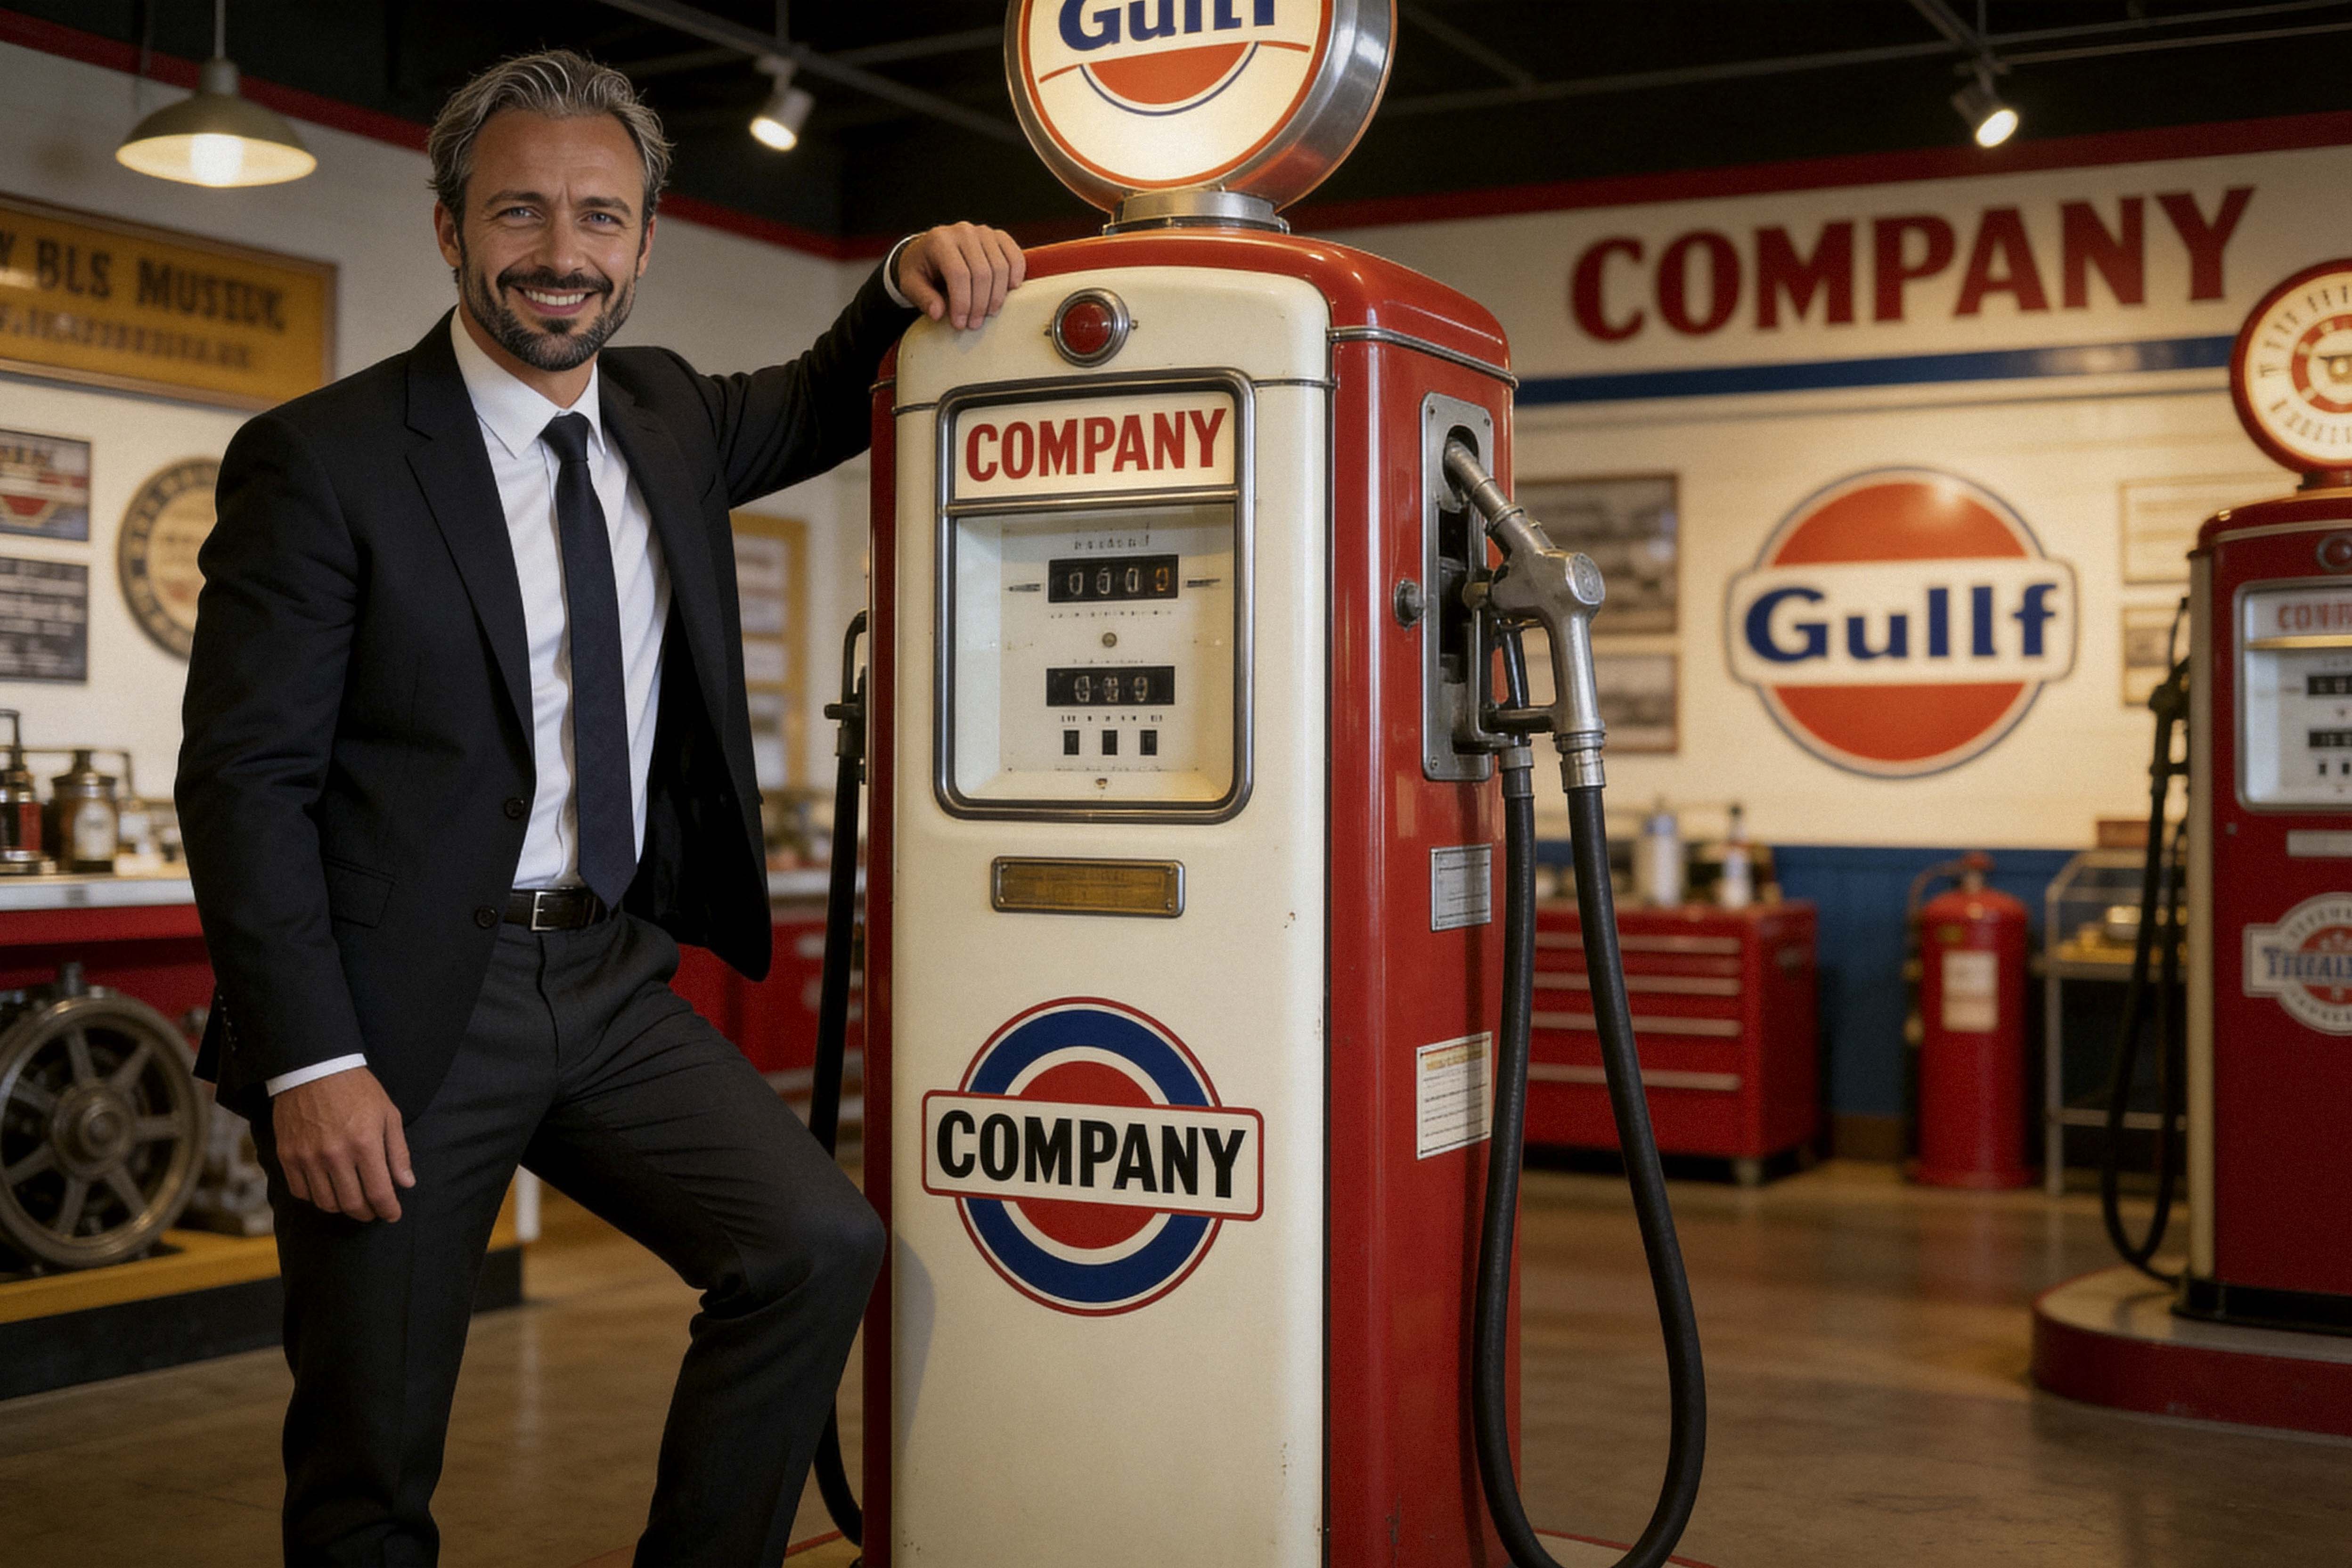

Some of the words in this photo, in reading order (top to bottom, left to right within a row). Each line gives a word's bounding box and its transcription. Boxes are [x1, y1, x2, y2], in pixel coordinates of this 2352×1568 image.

[1571, 186, 2257, 342] COMPANY
[966, 408, 1227, 482] COMPANY
[1745, 584, 2057, 663] Gullf
[937, 1110, 1246, 1199] COMPANY
